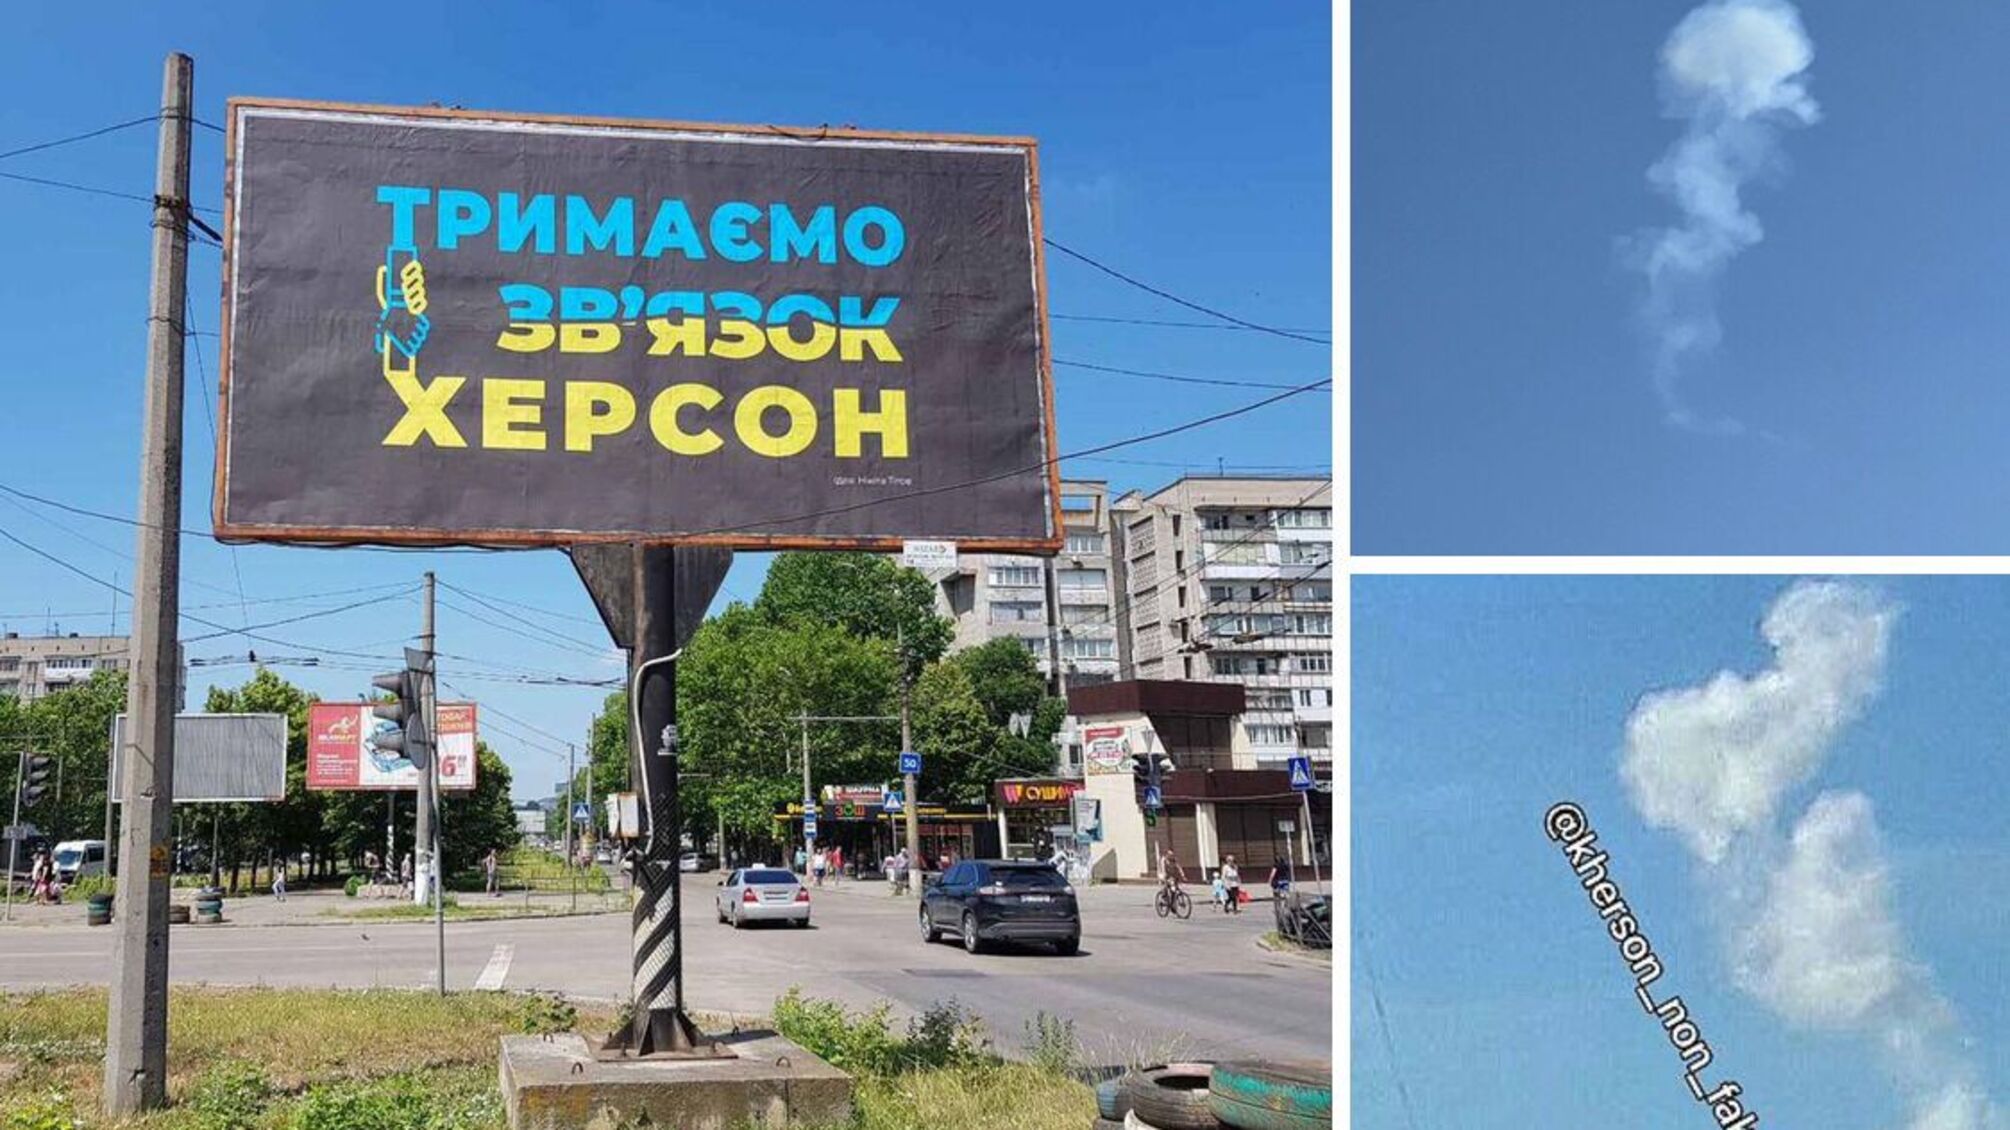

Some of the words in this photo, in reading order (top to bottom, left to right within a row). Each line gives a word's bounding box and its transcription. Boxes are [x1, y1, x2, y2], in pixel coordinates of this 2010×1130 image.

[376, 184, 906, 269] ТРИМАЄМО
[380, 374, 909, 459] ХЕРСОН
[903, 757, 917, 769] 50
